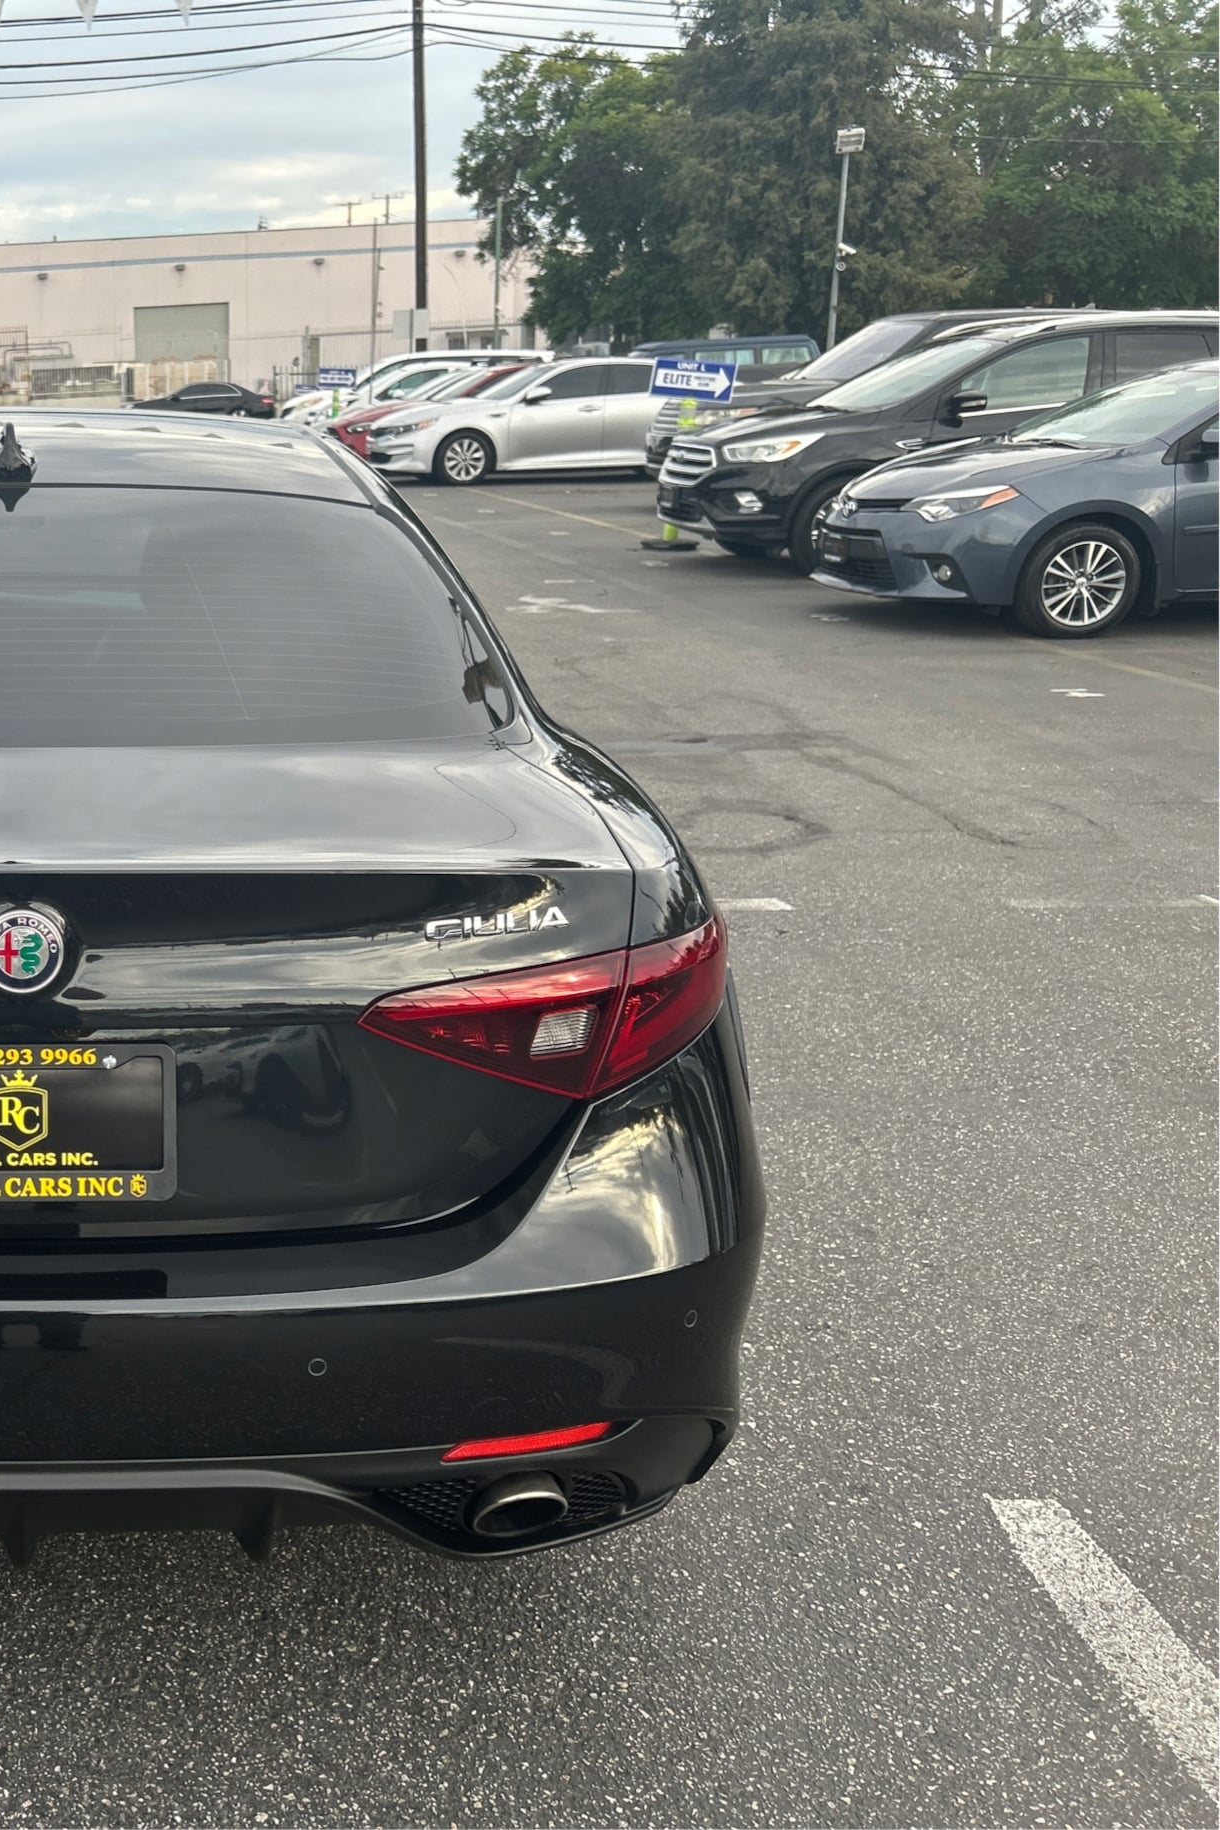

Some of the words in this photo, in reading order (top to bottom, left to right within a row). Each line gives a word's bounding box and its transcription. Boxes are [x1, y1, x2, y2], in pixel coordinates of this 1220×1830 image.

[677, 361, 699, 371] UNIT
[663, 373, 692, 386] ELITE
[426, 906, 570, 941] GIULIA
[18, 917, 58, 954] ROMEO
[40, 1048, 97, 1065] 9966
[6, 1152, 57, 1167] CARS
[61, 1152, 98, 1166] INC.
[4, 1177, 72, 1198] CARS
[77, 1177, 124, 1197] INC
